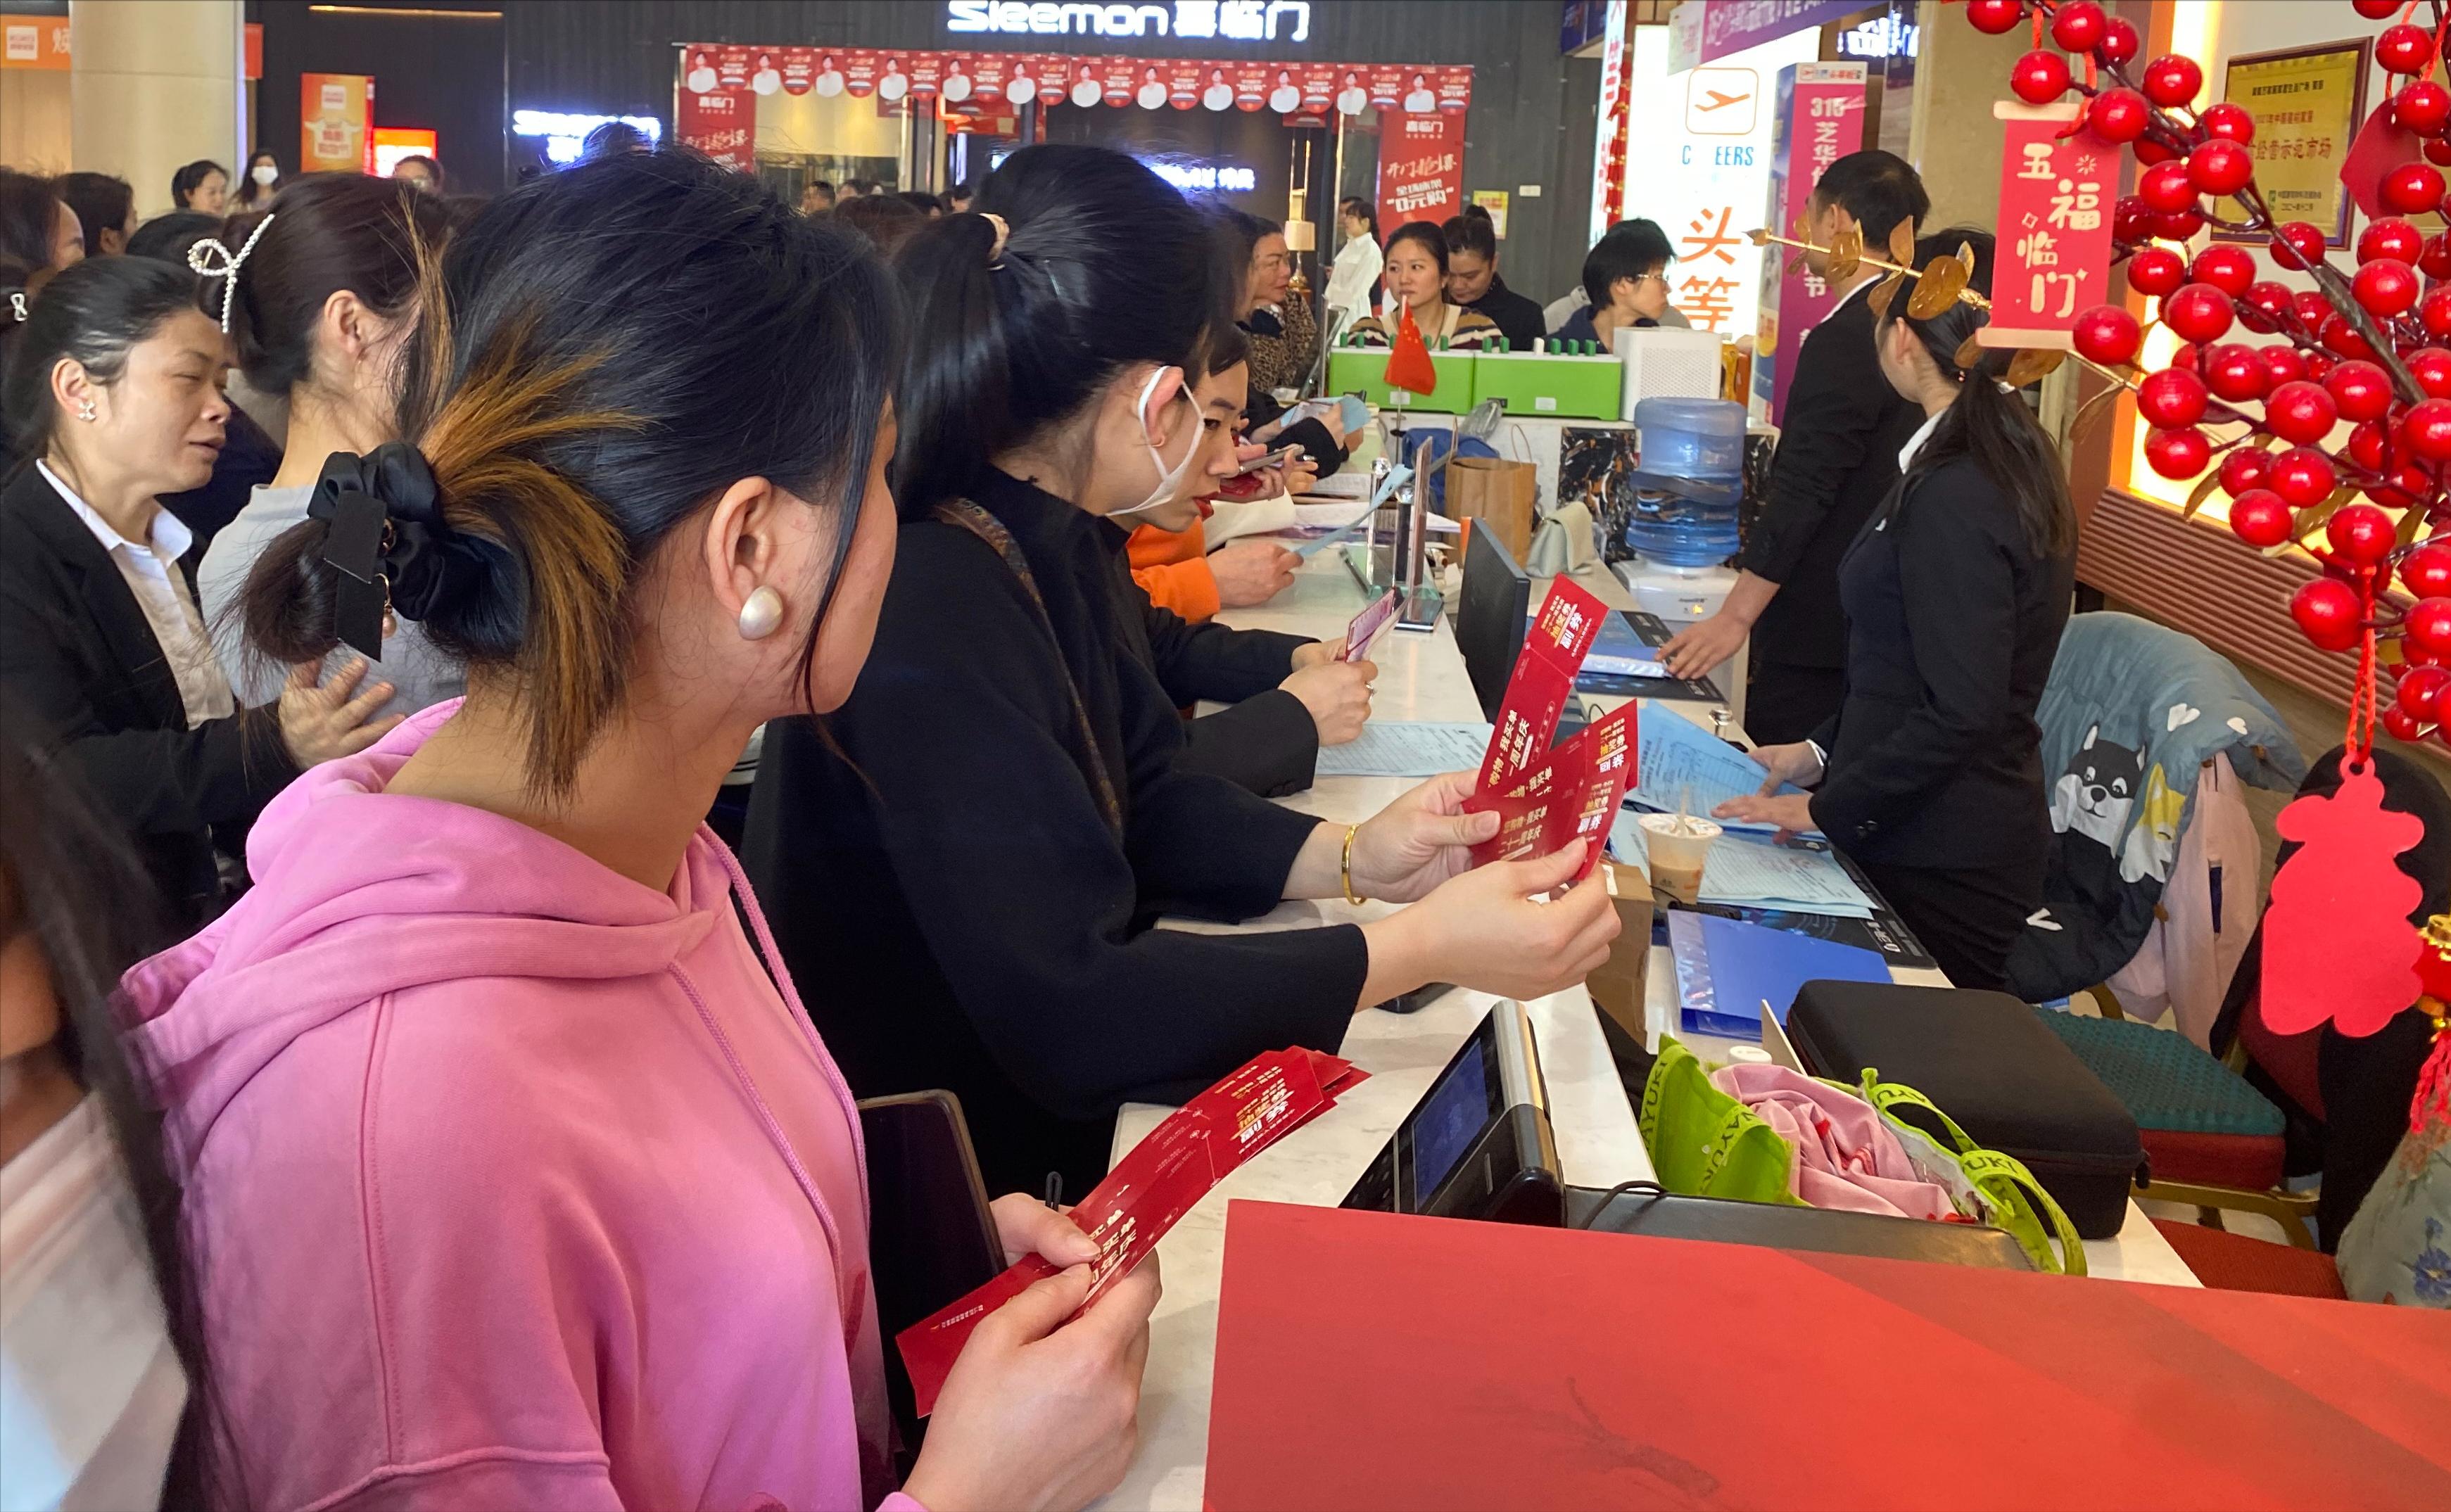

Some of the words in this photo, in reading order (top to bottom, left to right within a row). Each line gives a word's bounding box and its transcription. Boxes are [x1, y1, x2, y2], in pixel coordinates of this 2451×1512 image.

[2015, 142, 2101, 319] 五福临门
[1559, 612, 1583, 650] 副券
[1239, 1100, 1289, 1145] 副券
